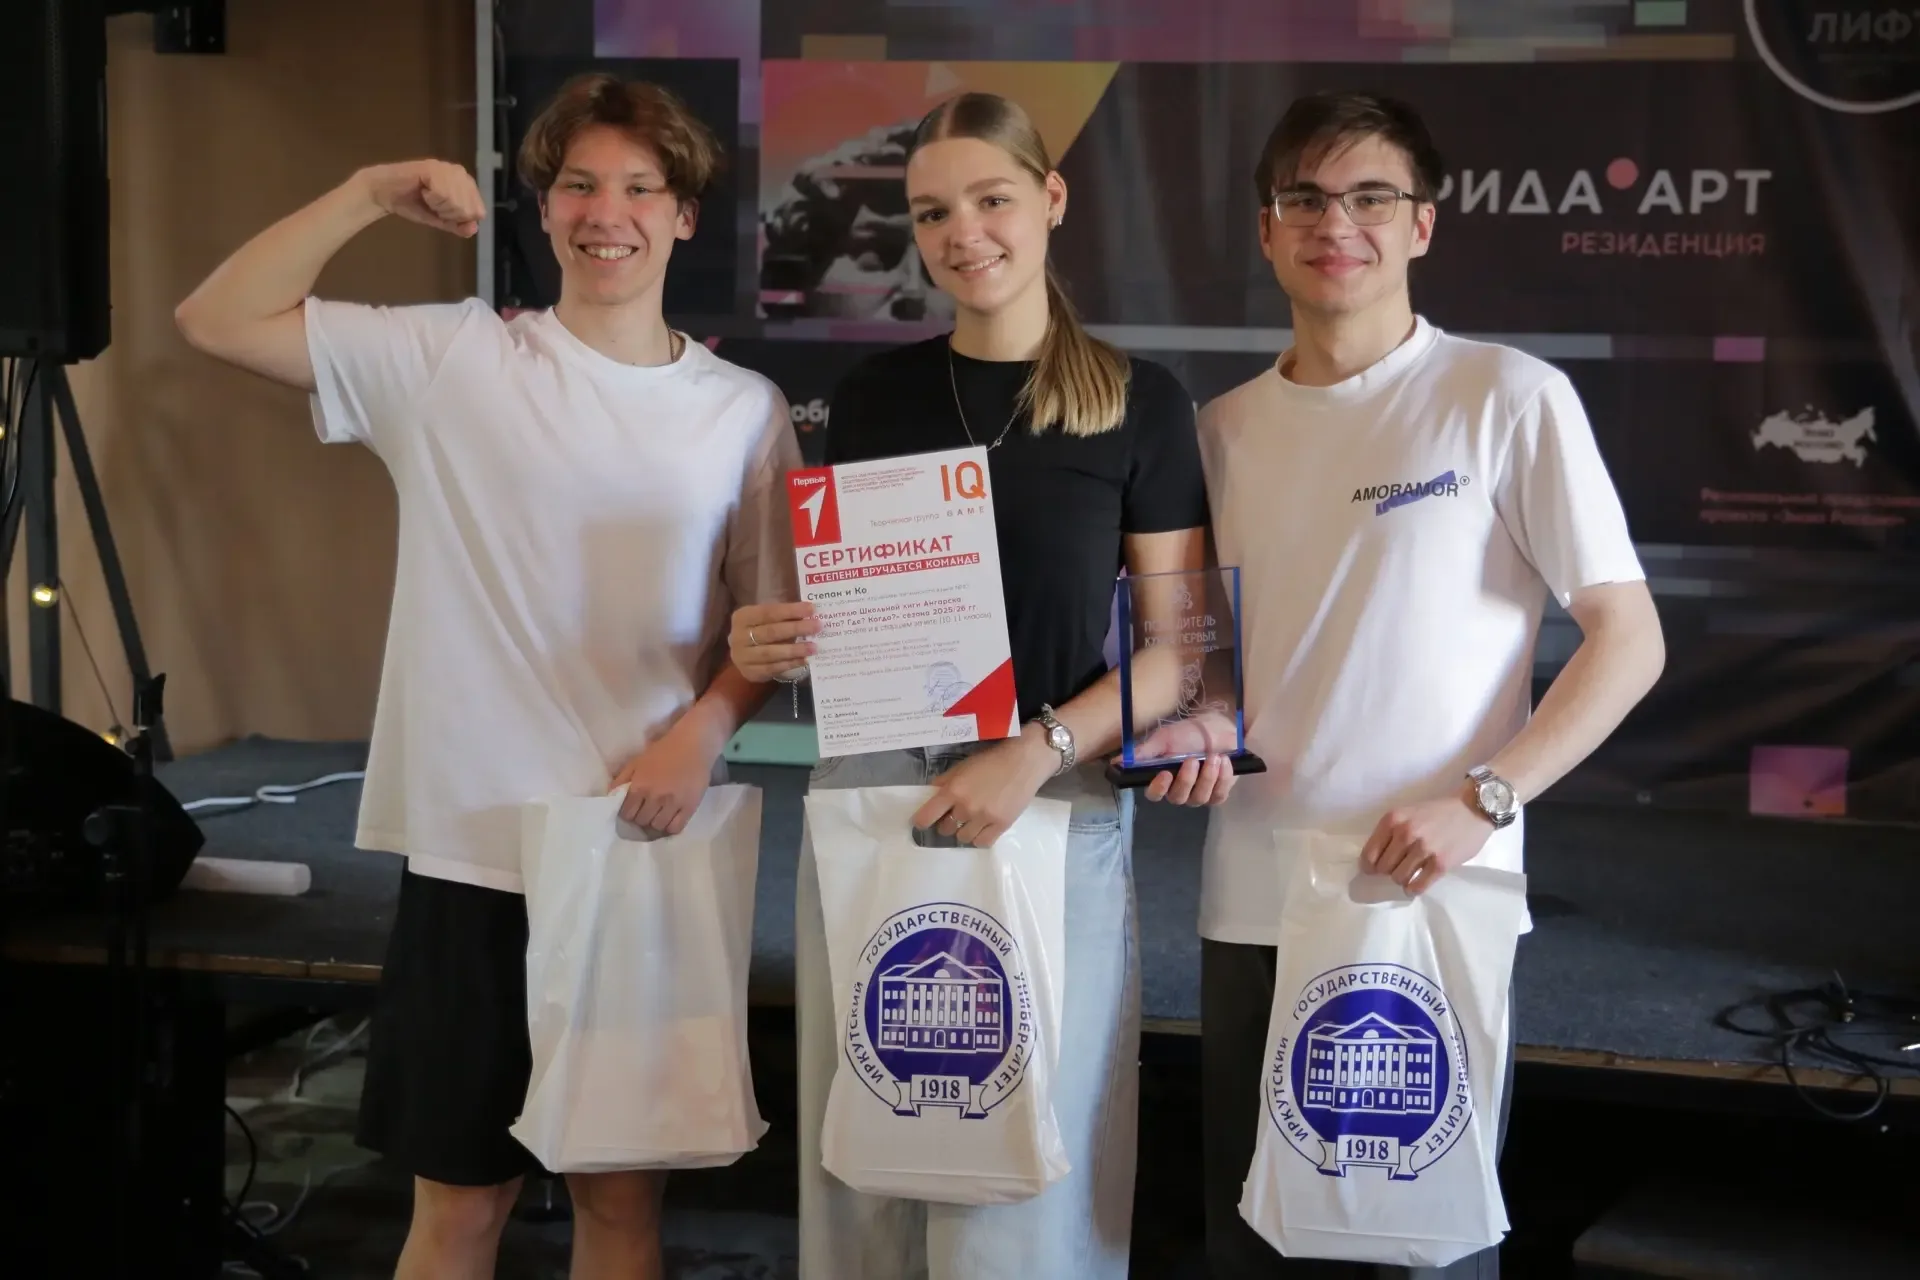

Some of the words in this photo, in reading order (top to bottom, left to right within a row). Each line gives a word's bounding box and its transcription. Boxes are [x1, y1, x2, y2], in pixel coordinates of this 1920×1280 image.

[1807, 8, 1920, 43] ЛИФ
[1638, 169, 1773, 215] АРТ
[1561, 231, 1767, 258] РЕЗИДЕНЦИЯ
[793, 475, 827, 487] Первые
[940, 460, 987, 502] IQ
[1351, 482, 1459, 503] AMORAMOR
[803, 535, 953, 569] СЕРТИФИКАТ
[813, 570, 860, 583] СТЕПЕНИ
[863, 561, 922, 577] ВРУЧАЕТСЯ
[926, 554, 979, 569] КОМАНДЕ
[807, 588, 843, 601] Степан
[854, 586, 867, 595] Ко
[866, 910, 1012, 964] ГОСУДАРСТВЕННЫЙ
[1292, 971, 1447, 1021] ГОСУДАРСТВЕННЫЙ
[849, 981, 884, 1083] ИРКУТСКИЙ
[920, 1078, 961, 1099] 1918
[1346, 1138, 1389, 1160] 1918
